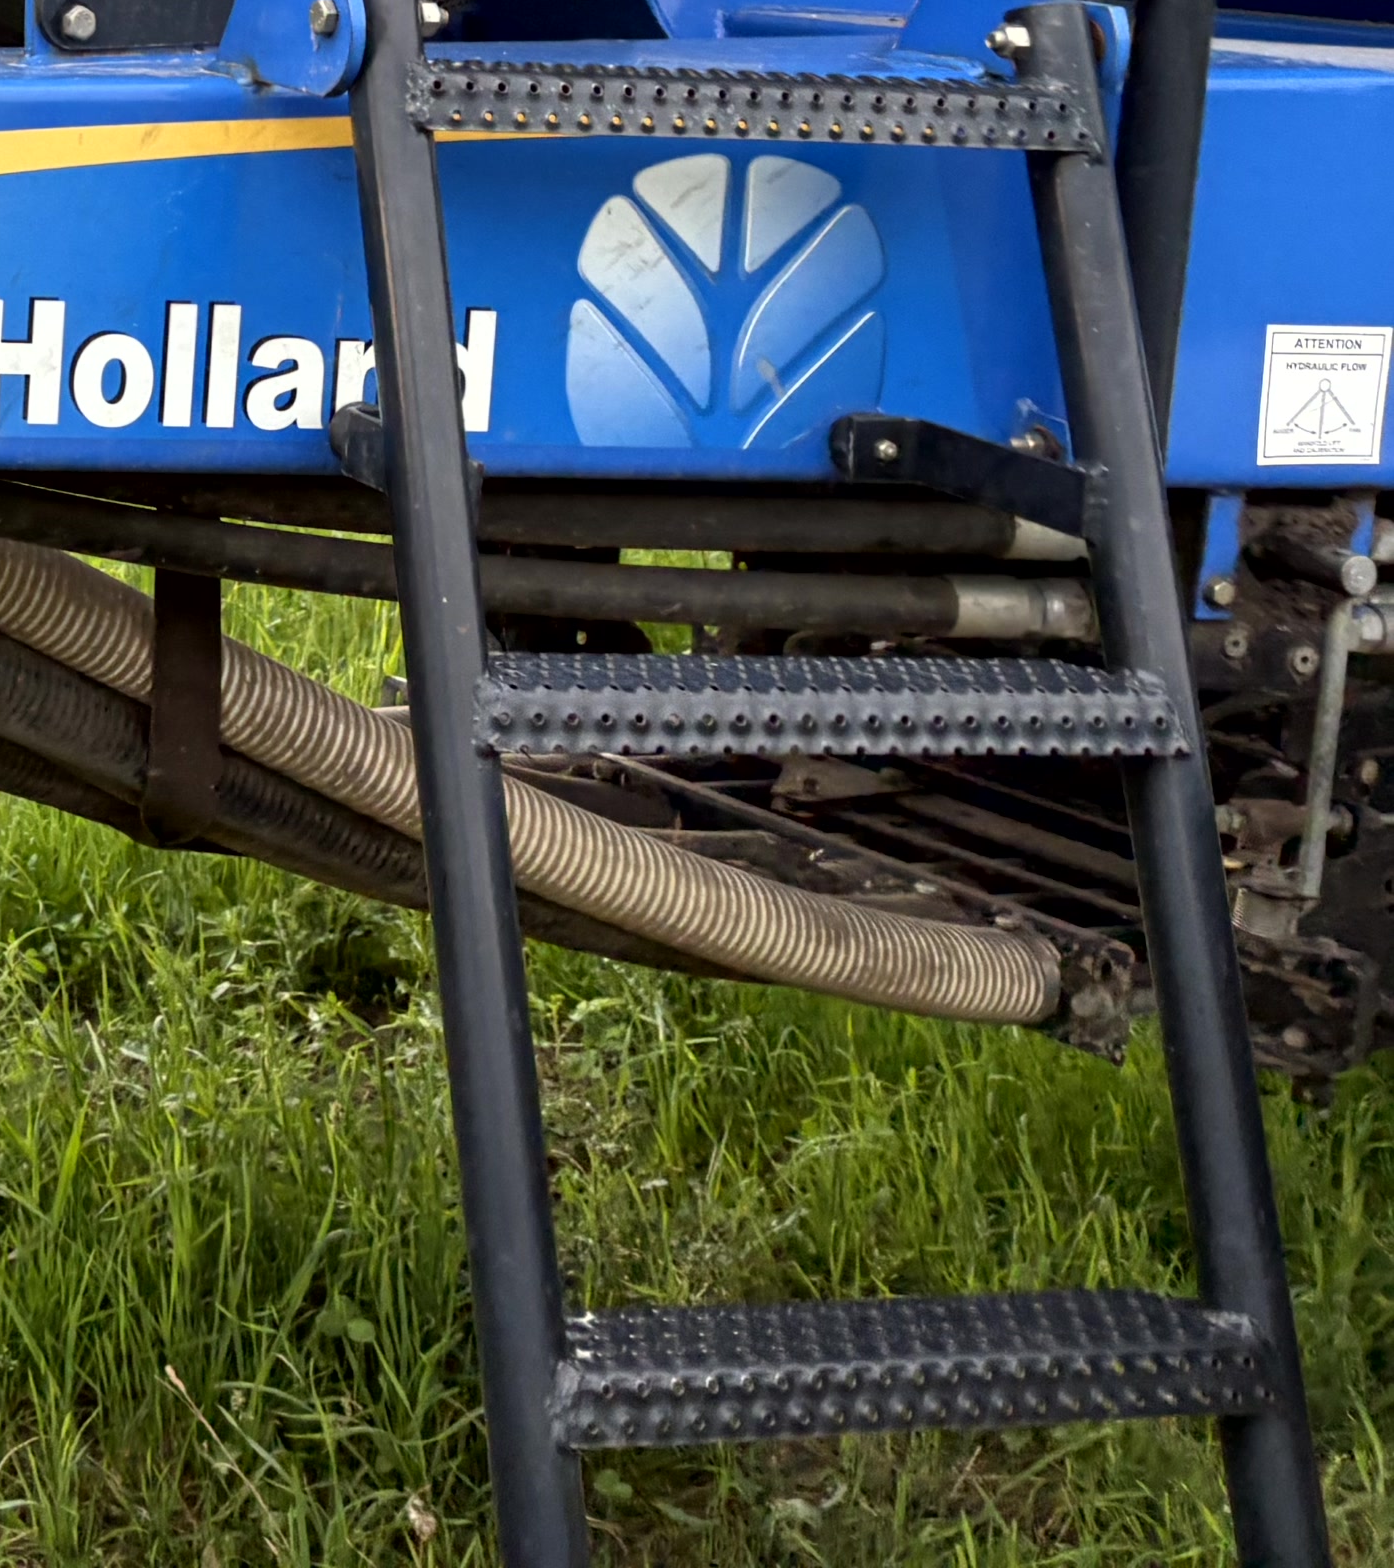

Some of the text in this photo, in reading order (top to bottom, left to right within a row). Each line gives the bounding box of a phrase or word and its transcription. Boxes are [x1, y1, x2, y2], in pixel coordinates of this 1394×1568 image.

[1295, 338, 1363, 350] ATTENTION
[1286, 362, 1367, 371] HYDRAULIC FLOW
